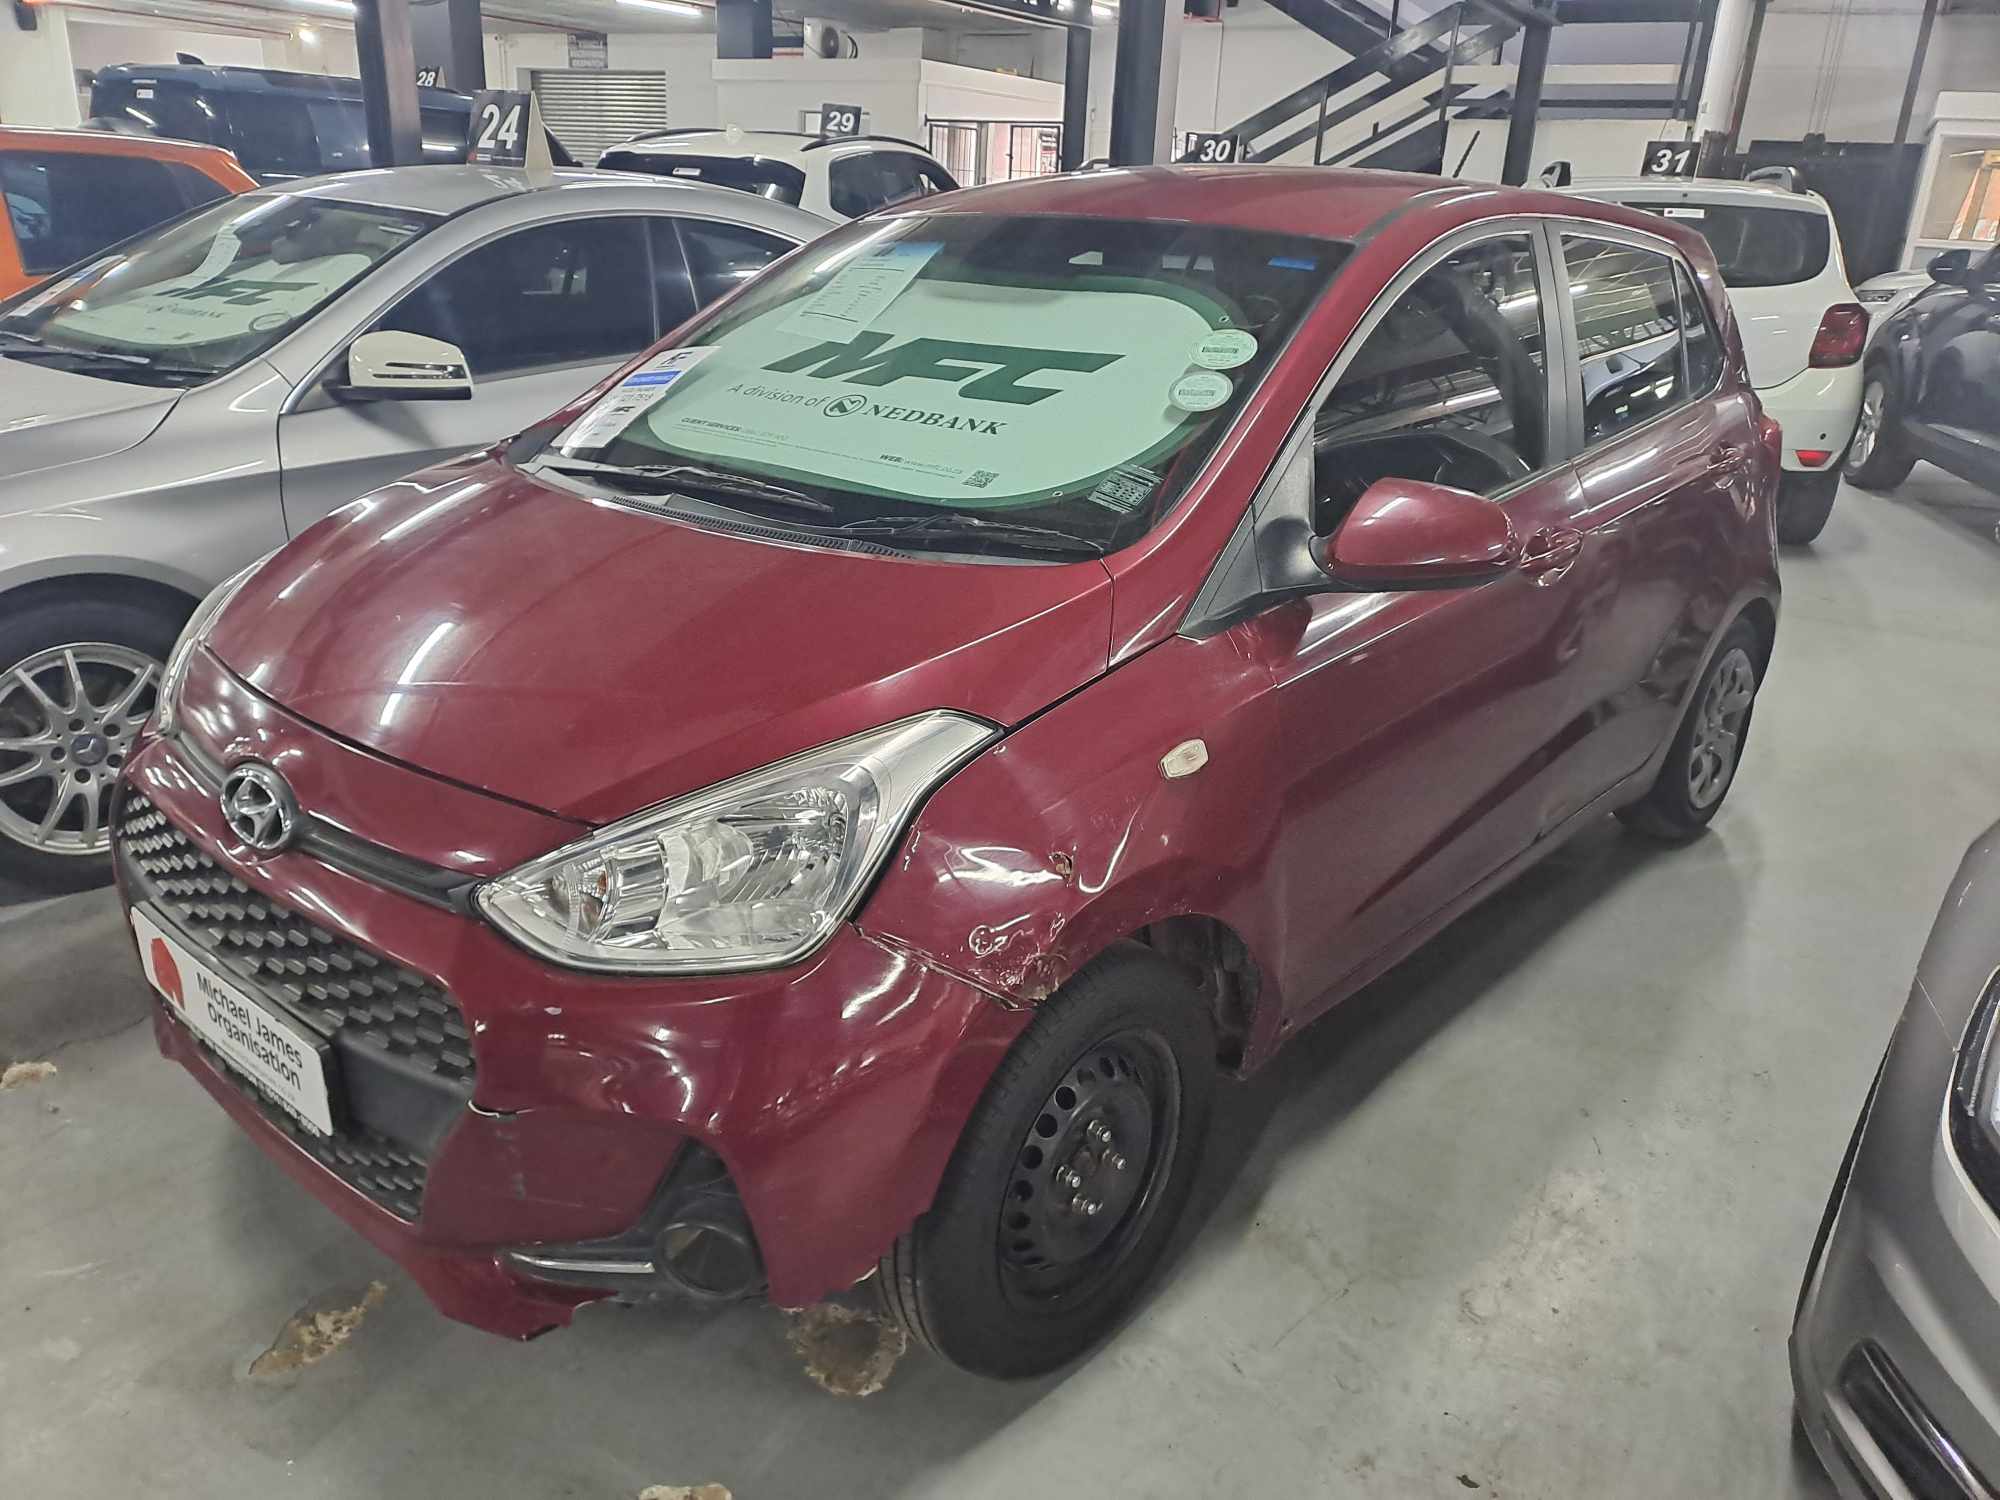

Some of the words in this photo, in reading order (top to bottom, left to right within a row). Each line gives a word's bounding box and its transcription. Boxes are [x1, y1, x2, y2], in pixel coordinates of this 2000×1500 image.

[416, 71, 436, 87] 28
[477, 104, 521, 149] 24
[826, 111, 855, 132] 29
[1200, 139, 1231, 161] 30
[1651, 149, 1691, 173] 31
[760, 330, 1127, 405] MFC
[727, 383, 744, 393] A
[743, 385, 801, 406] division
[803, 395, 831, 407] of
[862, 403, 1008, 435] NEDBANK
[196, 971, 251, 1026] Michael
[256, 1016, 304, 1070] James
[207, 1002, 302, 1091] Organisation
